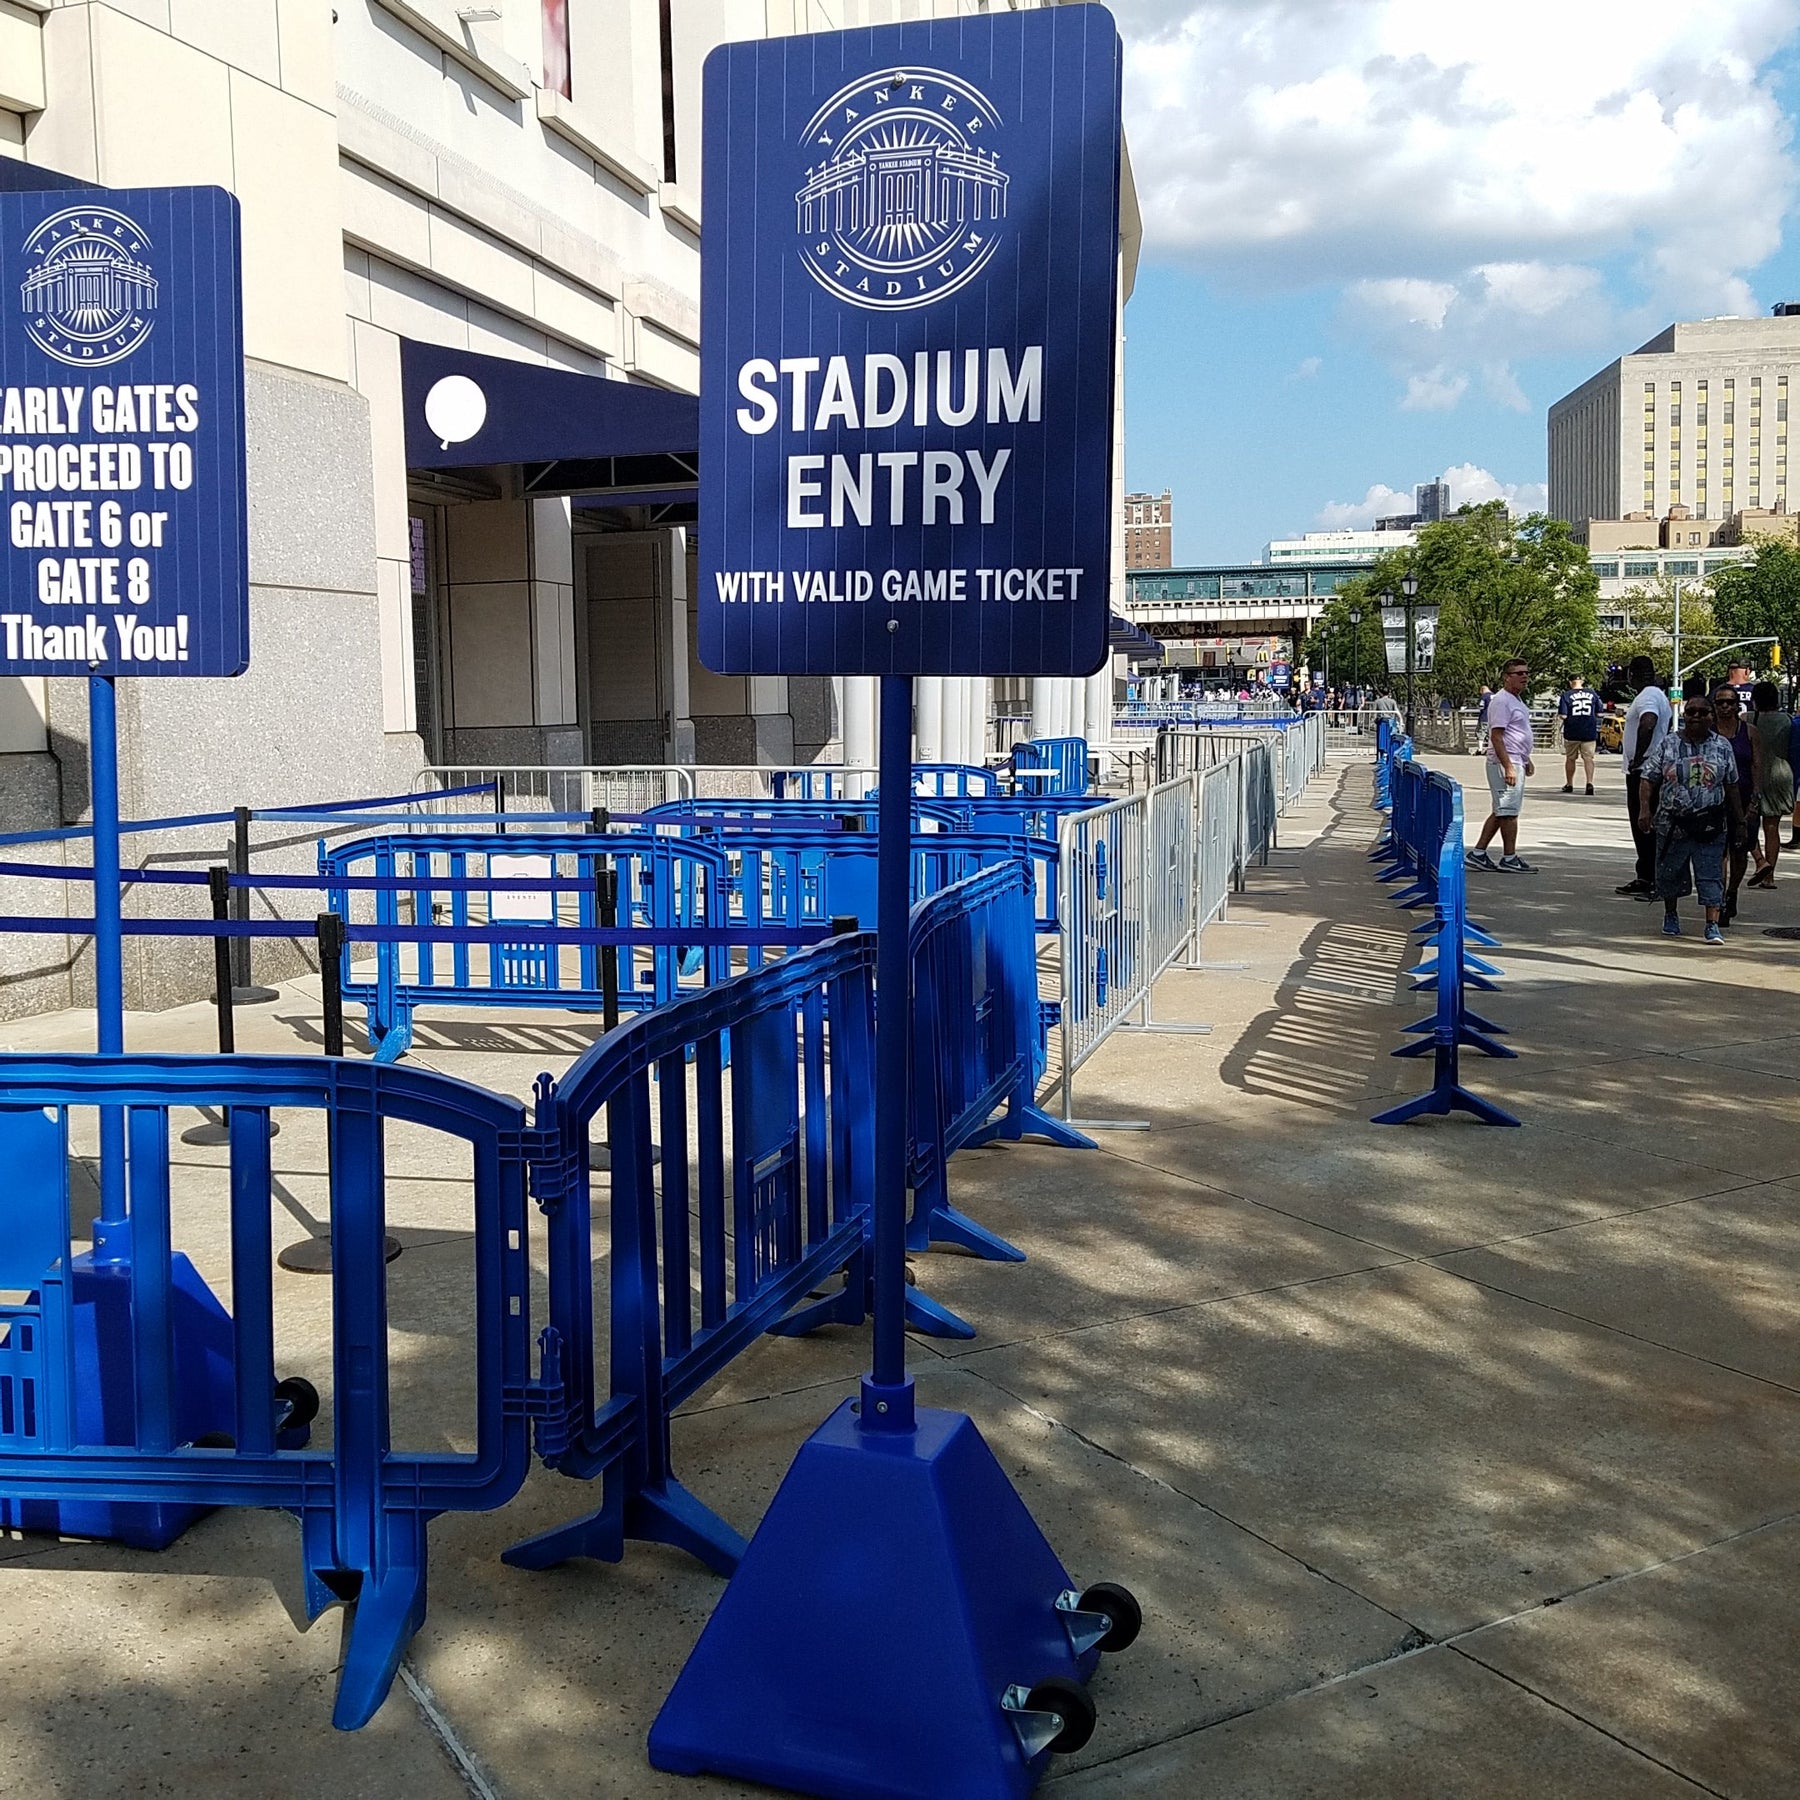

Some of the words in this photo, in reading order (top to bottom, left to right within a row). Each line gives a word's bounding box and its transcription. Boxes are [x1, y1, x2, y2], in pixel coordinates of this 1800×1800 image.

[818, 85, 983, 147] YANKEE
[34, 217, 141, 256] YANKEE
[816, 231, 983, 296] STADIUM
[34, 316, 144, 358] STADIUM
[0, 386, 85, 435] ARLY
[91, 383, 199, 434] GATES
[736, 345, 1043, 435] STADIUM
[0, 443, 142, 492] PROCEED
[148, 442, 193, 491] TO
[786, 448, 1012, 529] ENTRY
[10, 501, 92, 549] GATE
[99, 500, 122, 549] 6
[129, 512, 168, 549] or
[37, 558, 121, 606] GATE
[127, 557, 150, 605] 8
[715, 571, 784, 603] WITH
[793, 570, 873, 602] VALID
[881, 569, 967, 602] GAME
[975, 568, 1084, 601] TICKET
[2, 614, 109, 662] Thank
[114, 614, 189, 662] You!
[1572, 699, 1592, 716] 25
